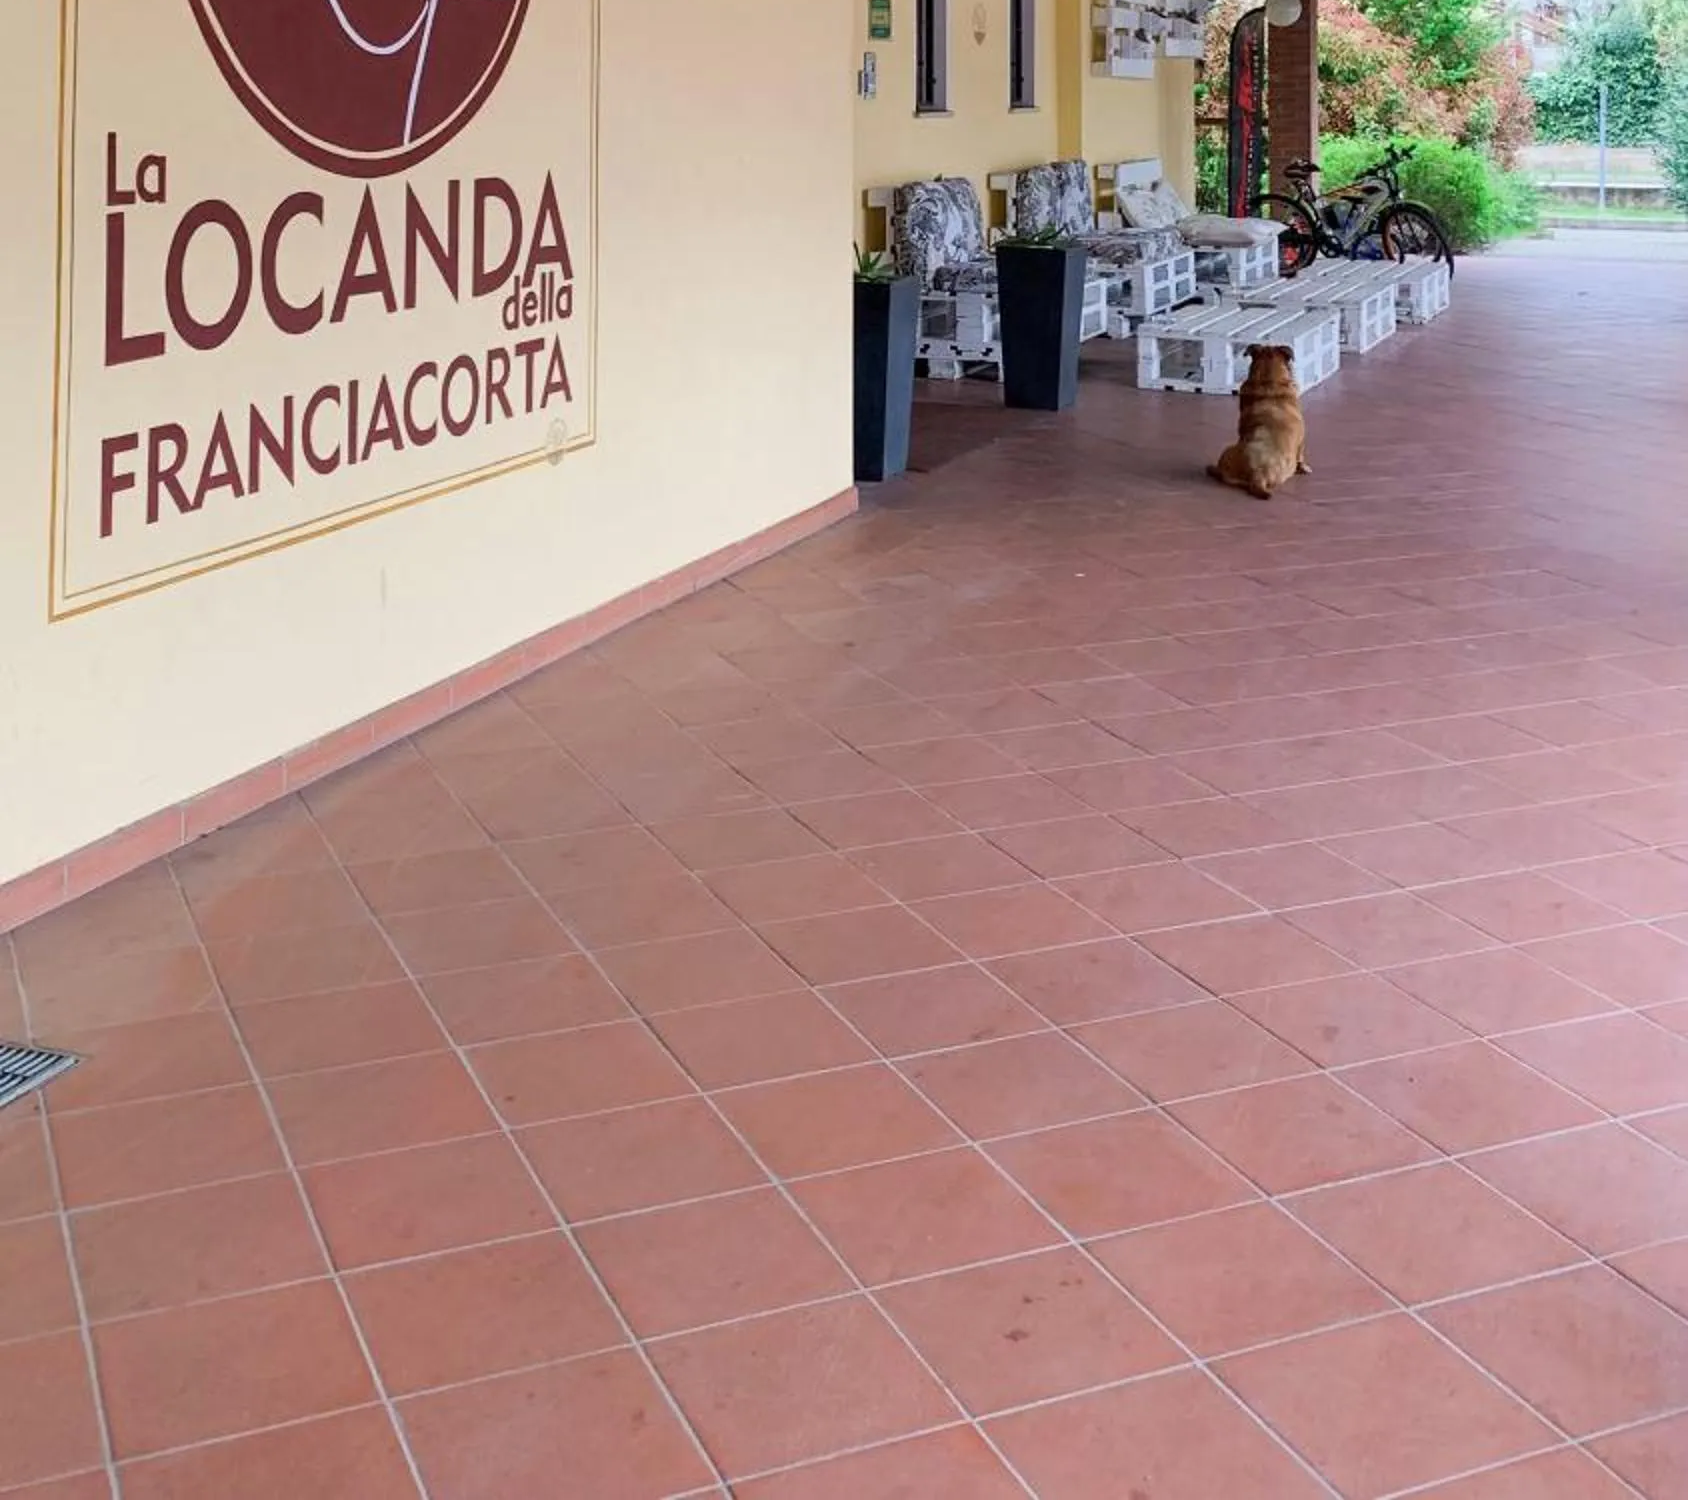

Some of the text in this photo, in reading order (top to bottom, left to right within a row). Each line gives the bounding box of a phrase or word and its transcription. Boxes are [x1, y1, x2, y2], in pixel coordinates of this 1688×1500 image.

[107, 131, 167, 206] La
[104, 169, 574, 367] LOCANDA
[502, 271, 574, 331] della
[100, 332, 573, 538] FRANCIACORTA
